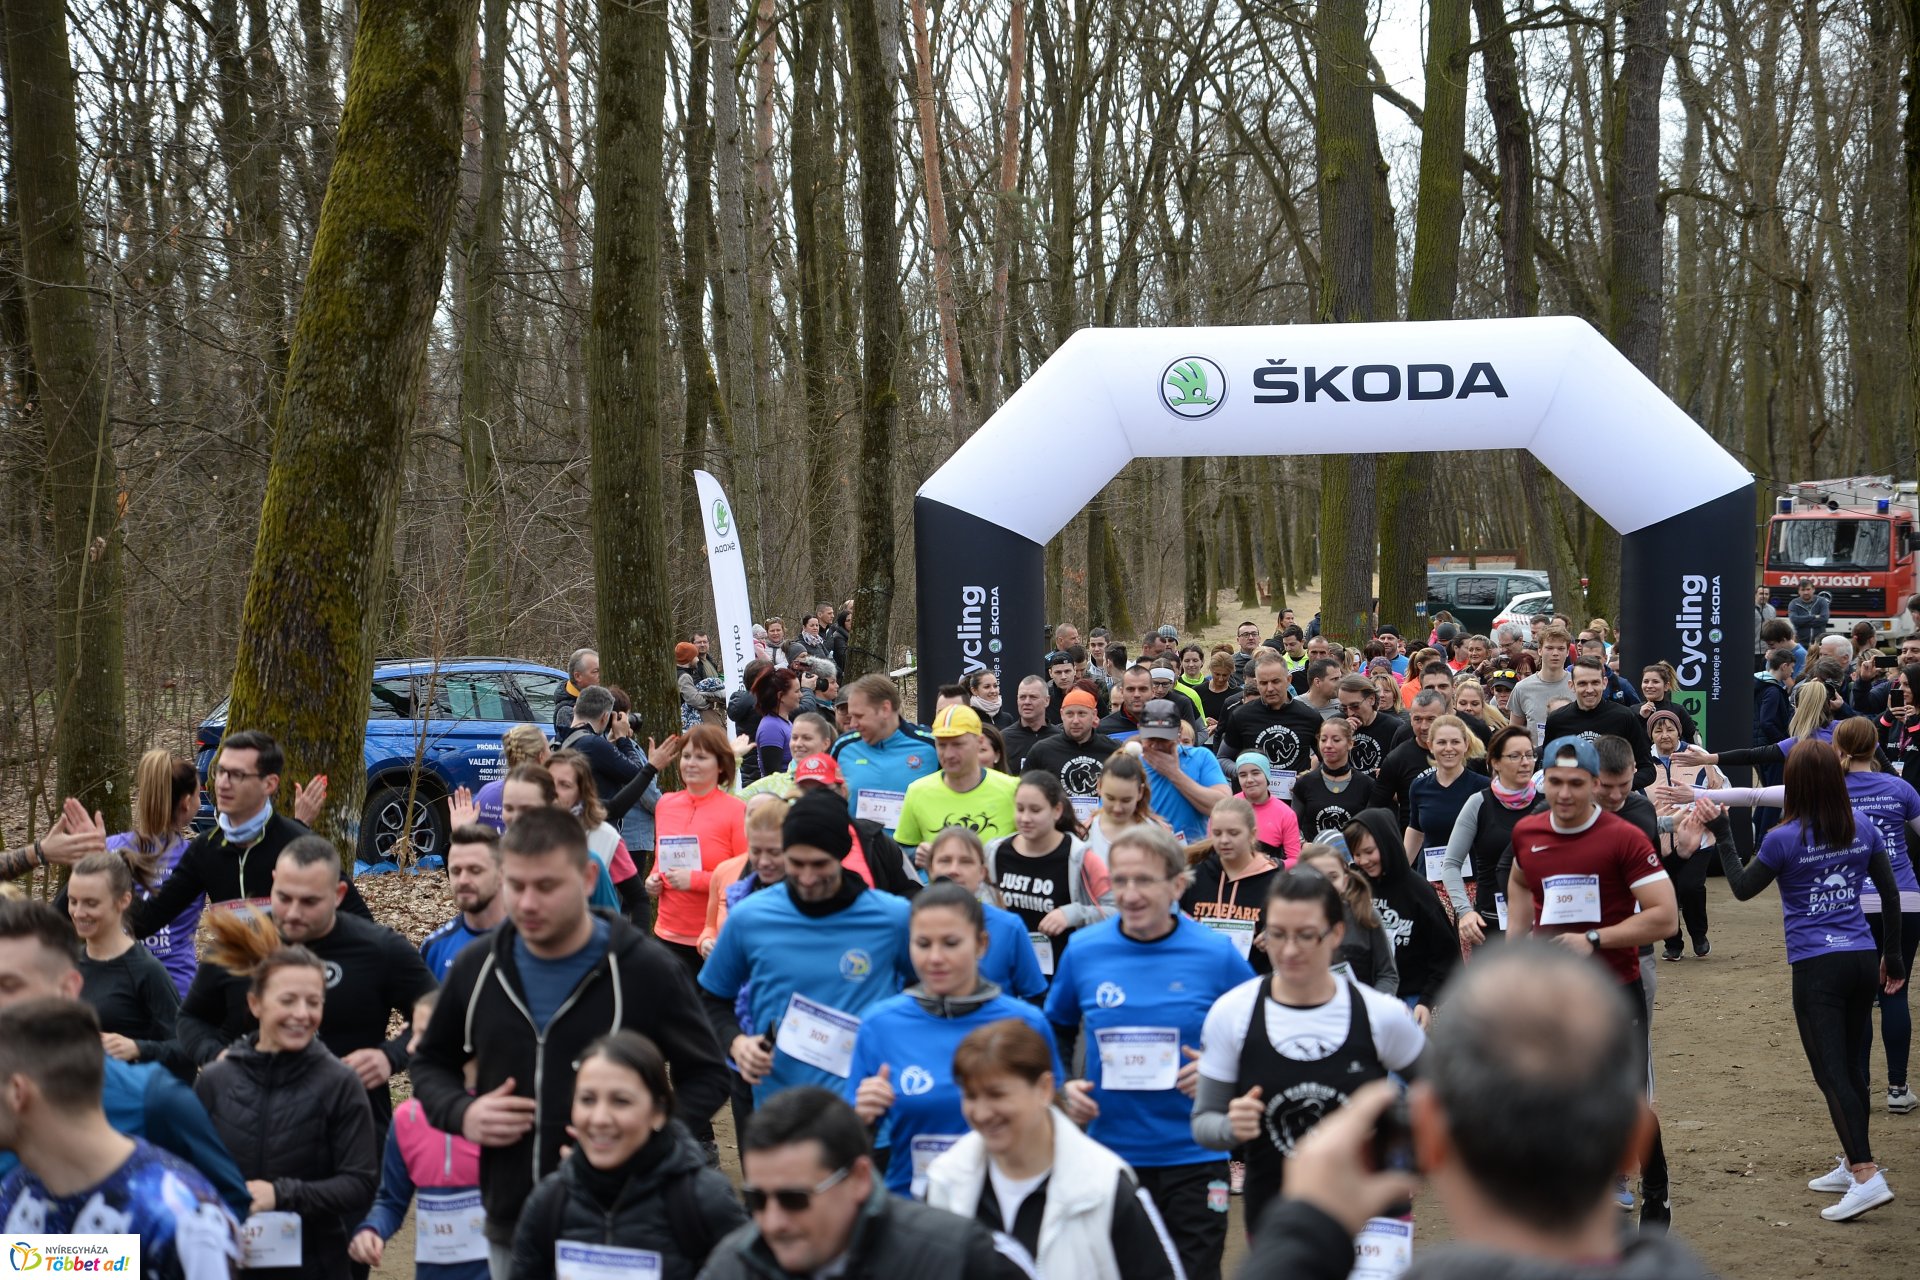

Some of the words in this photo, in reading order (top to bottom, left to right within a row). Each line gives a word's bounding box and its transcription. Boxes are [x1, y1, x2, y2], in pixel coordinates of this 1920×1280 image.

[1253, 358, 1509, 404] ŠKODA
[990, 586, 1000, 635] ŠKODA
[1710, 575, 1720, 624] ŠKODA
[957, 586, 986, 683] ycling
[1676, 574, 1708, 686] Cycling
[1712, 655, 1722, 700] Hajtóereje
[1576, 731, 1602, 739] WARRIO
[468, 758, 496, 766] VALENT
[496, 758, 507, 766] AU
[1826, 849, 1848, 859] sportoló
[1000, 872, 1031, 892] JUST
[1032, 878, 1054, 895] DO
[1001, 891, 1054, 913] OTHING
[1372, 898, 1390, 910] EAL
[1556, 894, 1573, 903] 309
